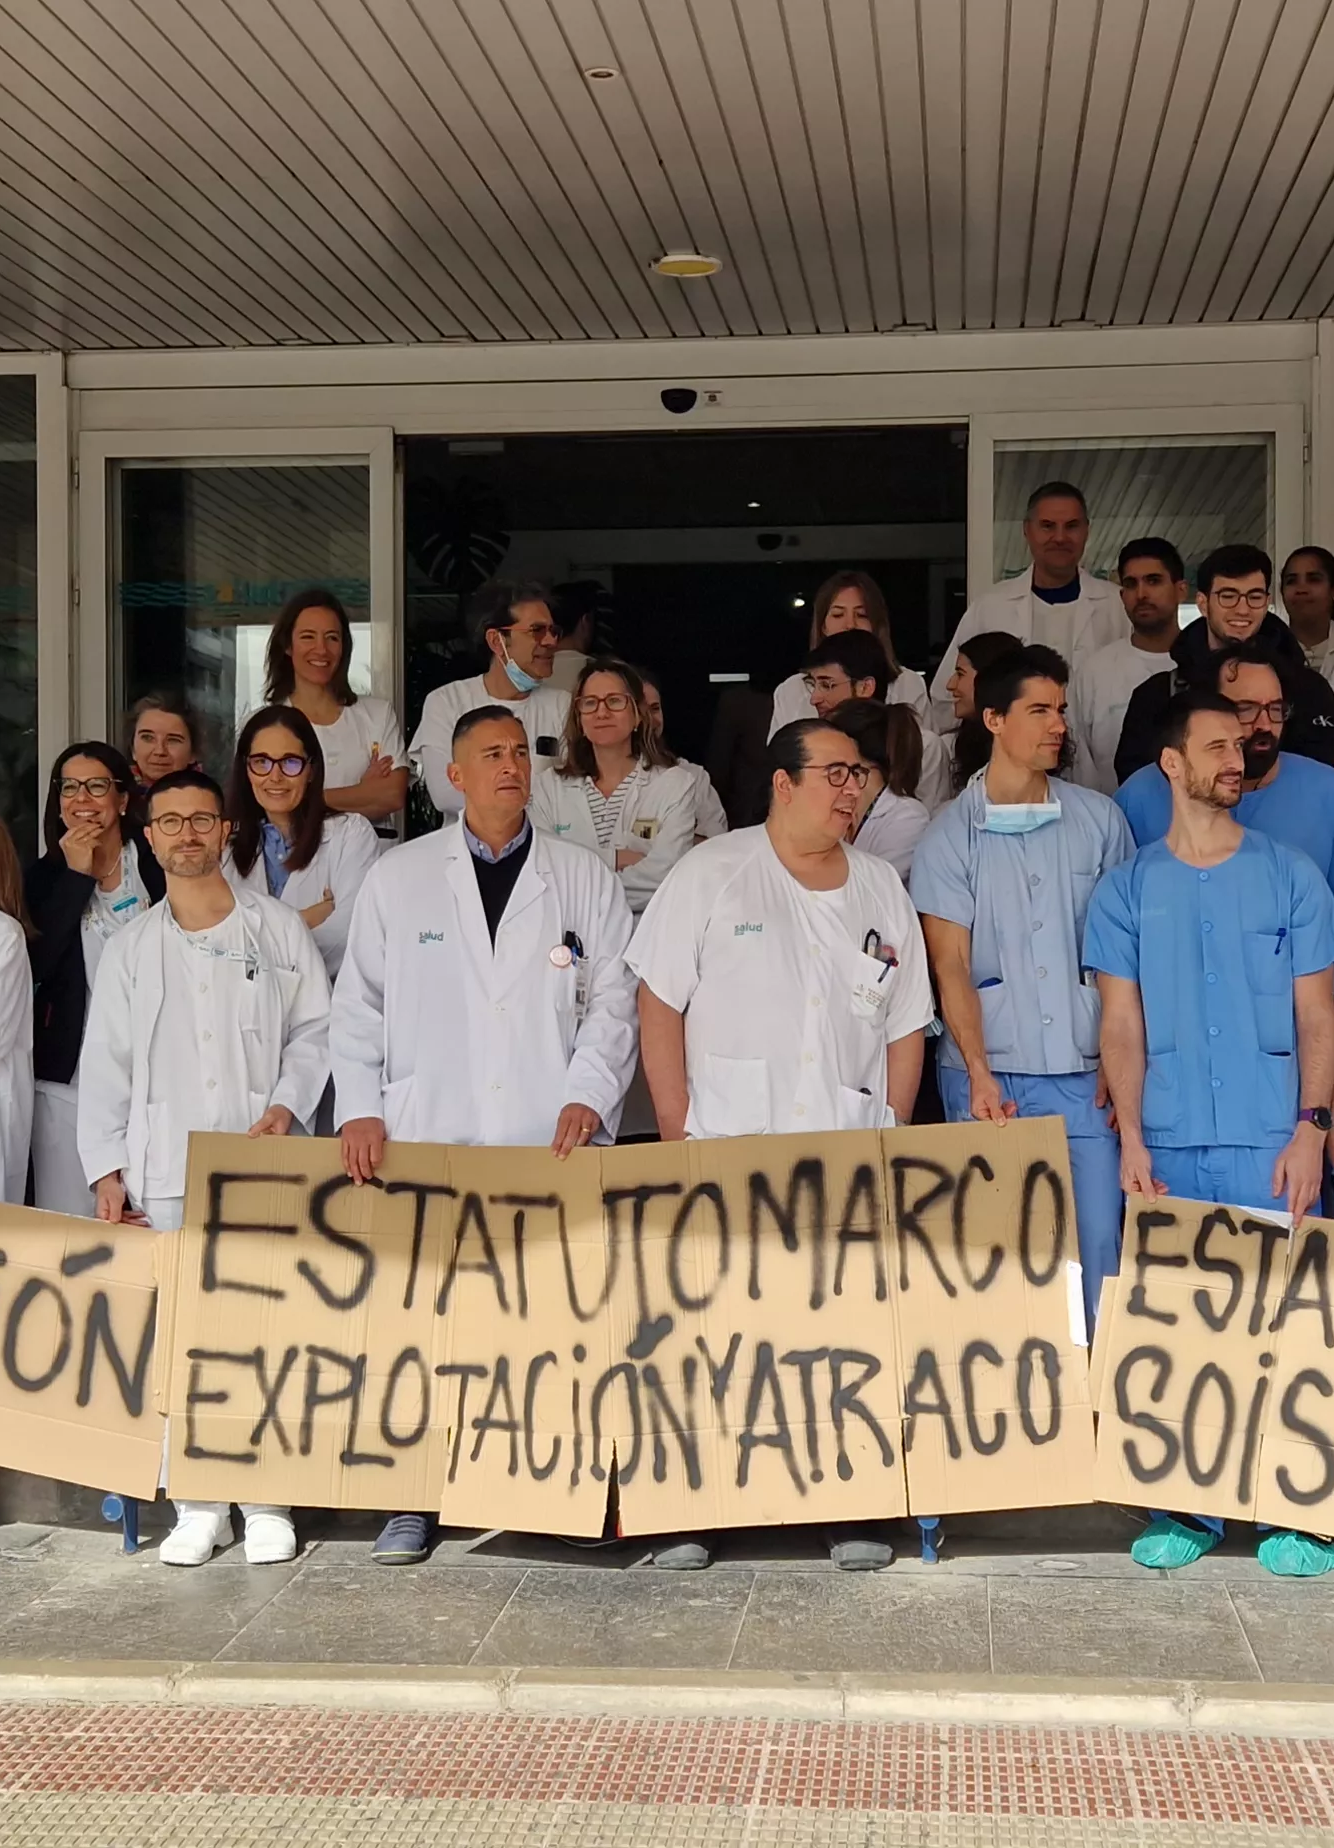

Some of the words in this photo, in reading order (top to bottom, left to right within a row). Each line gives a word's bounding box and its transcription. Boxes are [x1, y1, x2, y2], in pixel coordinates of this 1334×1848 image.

[419, 930, 444, 942] salud
[734, 921, 763, 933] salud
[202, 1172, 731, 1326] ESTATUTO
[747, 1155, 1067, 1309] MARCO
[735, 1335, 1063, 1495] ATRACO
